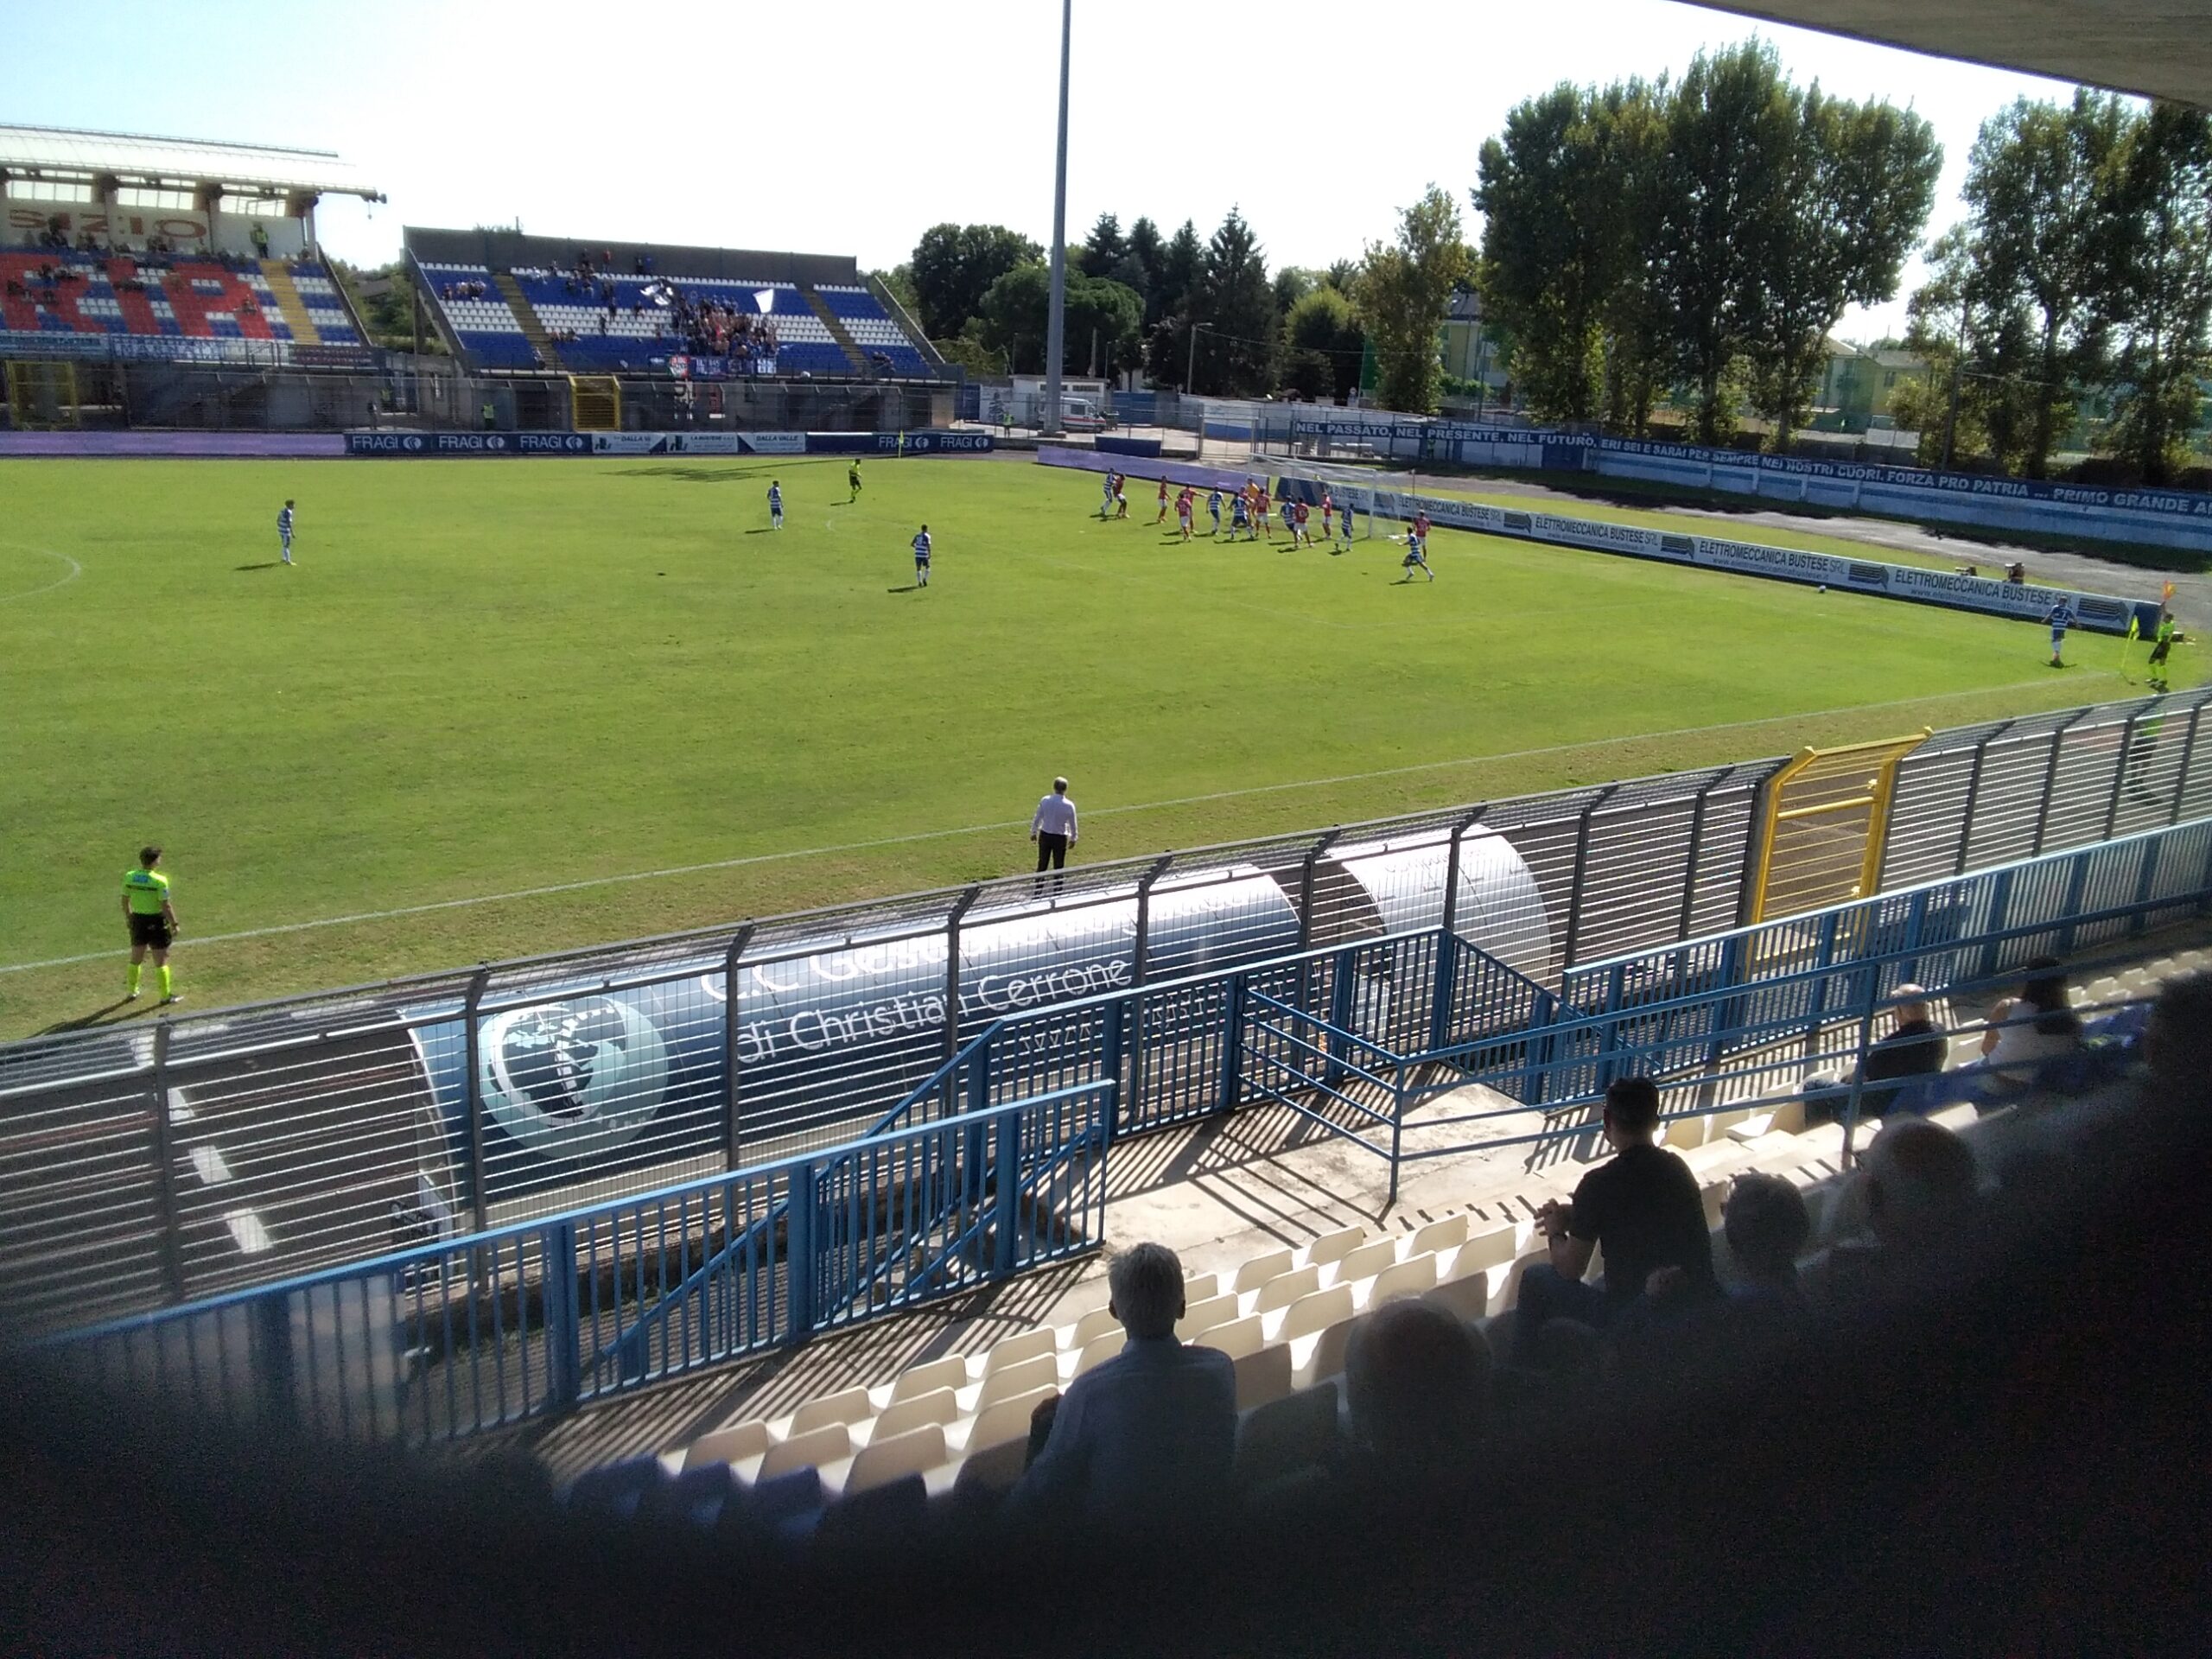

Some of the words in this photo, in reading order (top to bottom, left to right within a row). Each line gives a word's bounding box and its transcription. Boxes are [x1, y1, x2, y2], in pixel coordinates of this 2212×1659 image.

[352, 435, 398, 449] FRAGI
[438, 435, 483, 448] FRAGI
[519, 435, 562, 448] FRAGI
[879, 435, 912, 448] FRAGI
[940, 436, 972, 448] FRAGI
[1296, 423, 1323, 433] NEL
[1326, 424, 1393, 437] PASSATO,
[1396, 427, 1423, 438] NEL
[1507, 434, 1535, 443] NEL
[1600, 439, 1621, 449] ERI
[1624, 442, 1642, 453] SEI
[1643, 444, 1651, 453] E
[1653, 445, 1688, 457] SARAI
[1689, 449, 1710, 461] PER
[1713, 453, 1759, 465] SEMPRE
[1786, 461, 1834, 474] NOSTRI
[1887, 471, 1935, 486] FORZA
[1938, 477, 1969, 490] PRO
[1973, 481, 2029, 496] PATRIA
[2054, 488, 2109, 503] PRIMO
[2113, 493, 2190, 512] GRANDE
[1461, 504, 1490, 520] BUSTESE
[1535, 516, 1609, 538] ELETTROMECCANICA
[1611, 527, 1644, 543] BUSTESE
[1645, 534, 1658, 546] SRL
[1700, 540, 1787, 565] ELETTROMECCANICA
[1789, 554, 1828, 571] BUSTESE
[1829, 561, 1846, 575] SRL
[1895, 569, 1999, 597] ELETTROMECCANICA
[2002, 584, 2051, 604] BUSTESE
[978, 959, 1133, 1012] Cerrone
